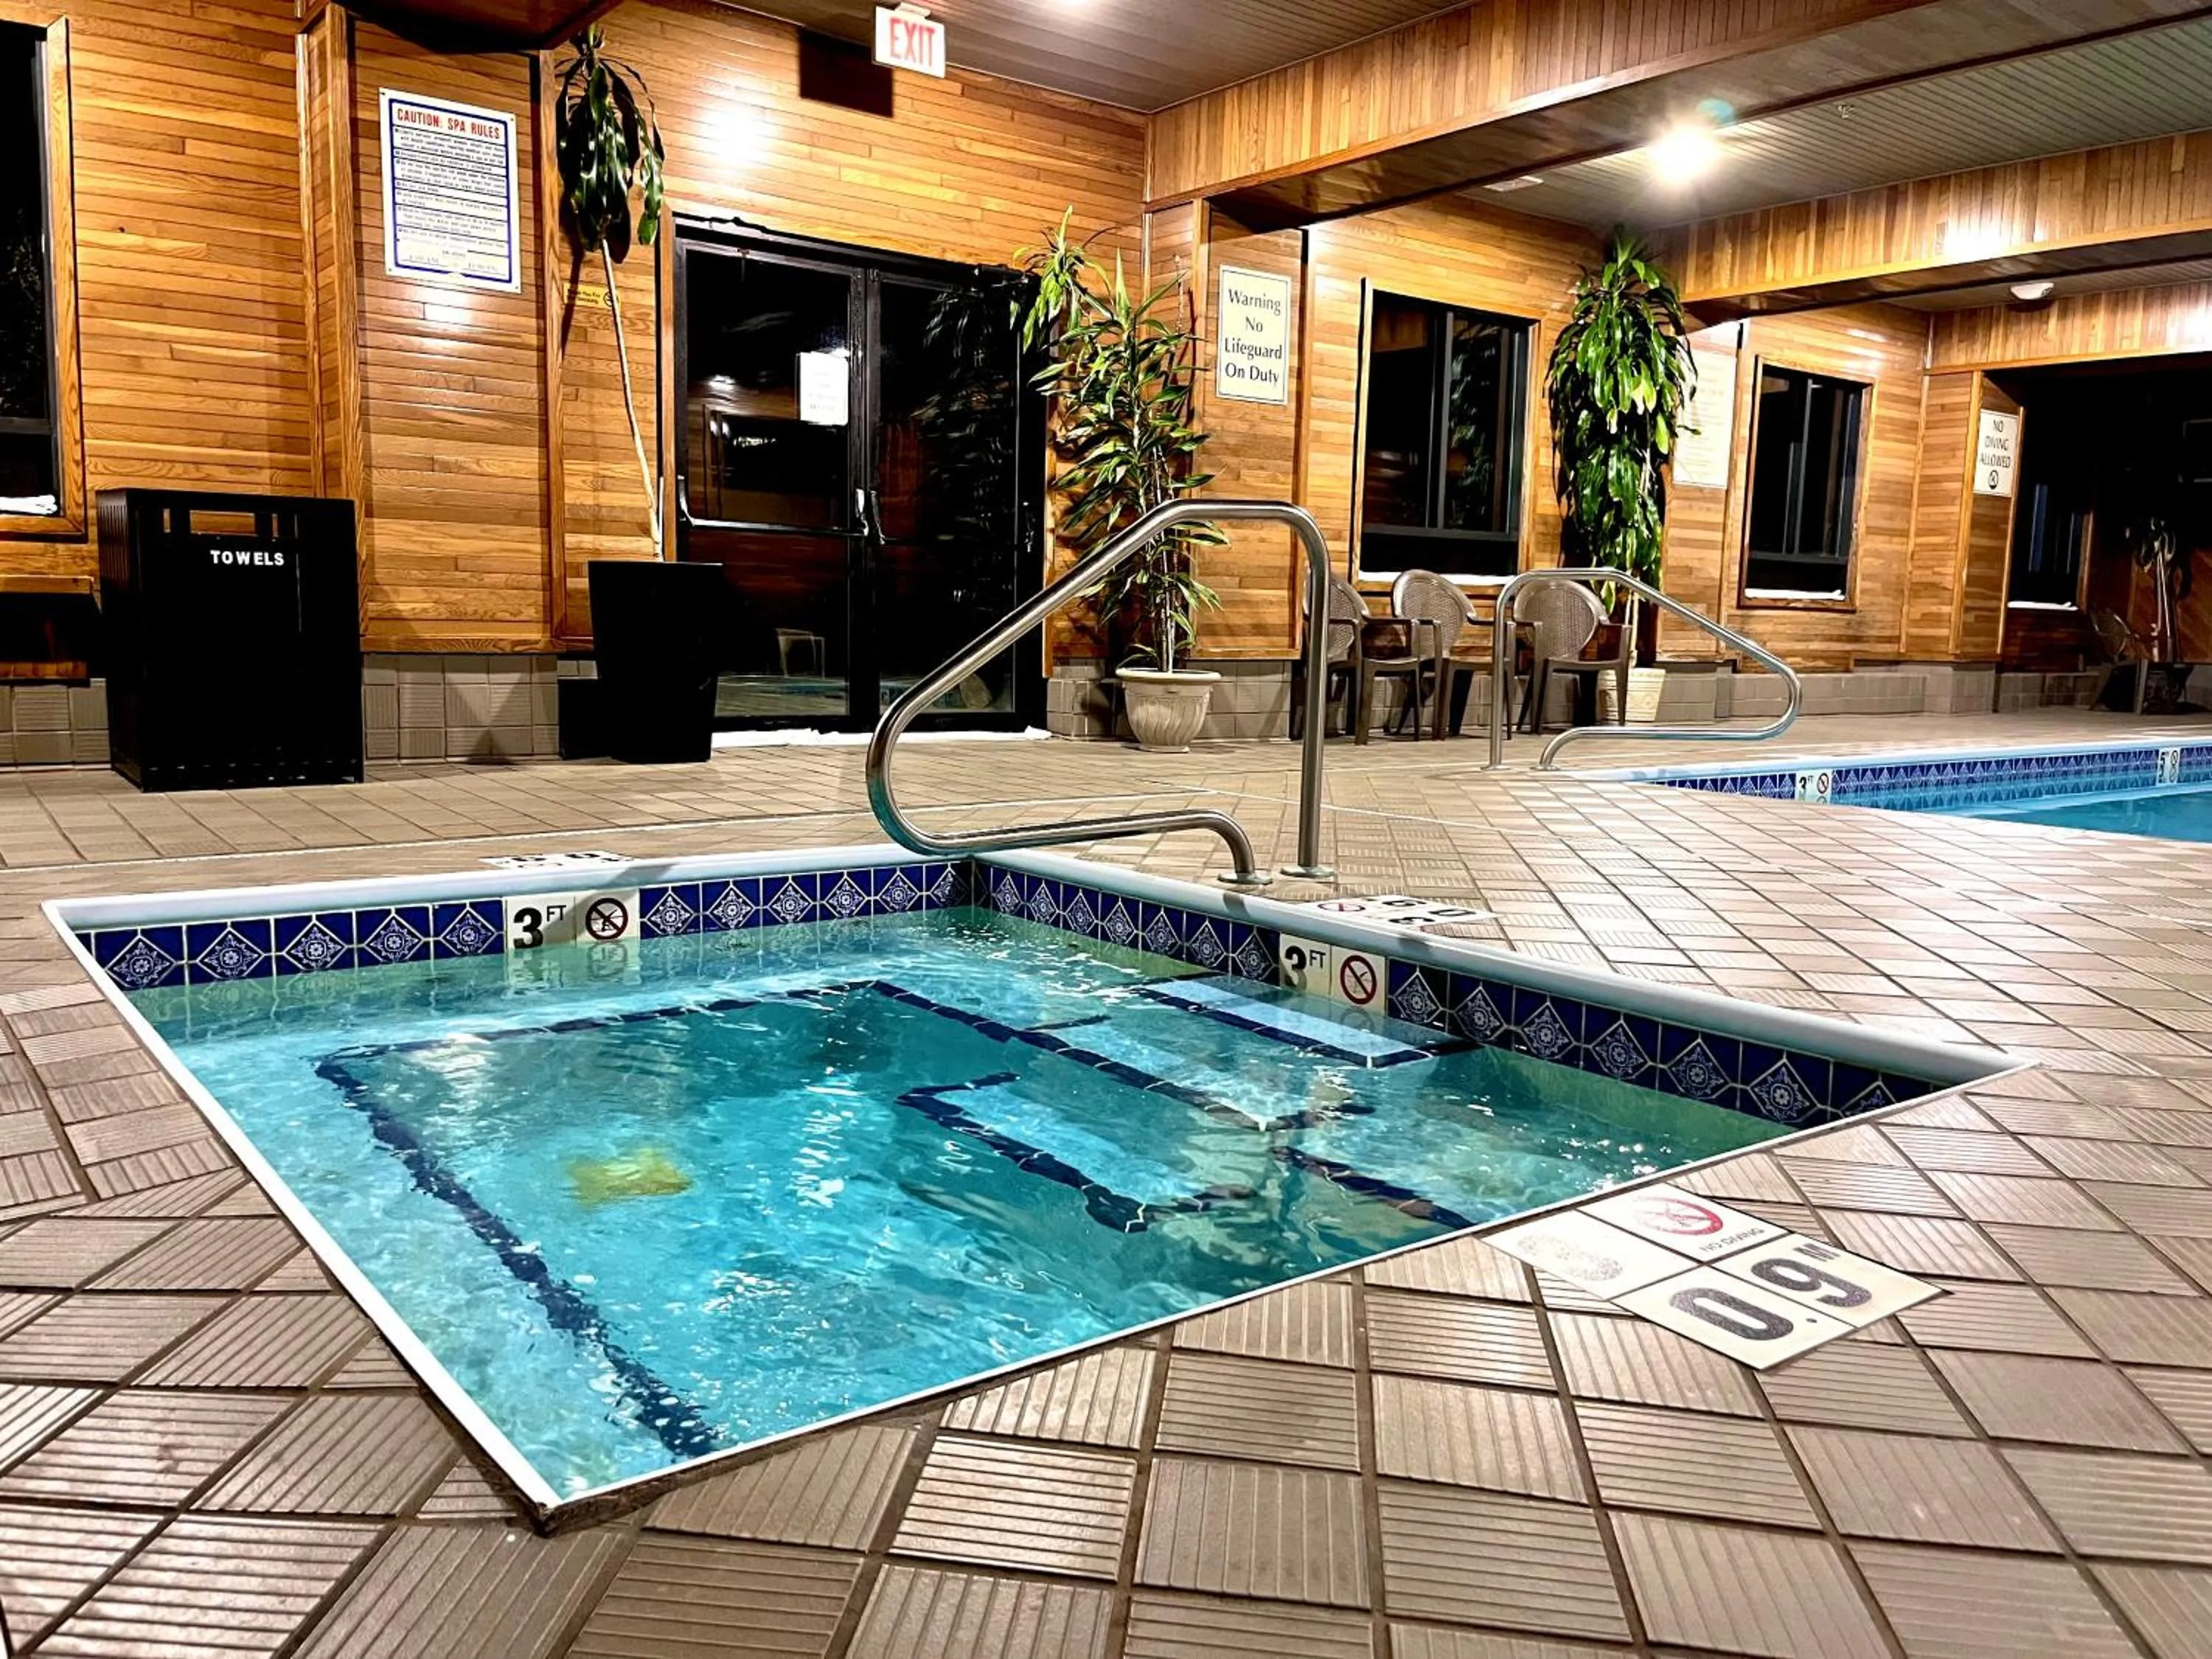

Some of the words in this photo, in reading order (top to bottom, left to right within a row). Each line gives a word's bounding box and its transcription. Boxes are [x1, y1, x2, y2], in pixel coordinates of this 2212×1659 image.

[889, 17, 936, 67] EXIT
[448, 117, 466, 132] SPA
[471, 122, 501, 139] RULES
[1228, 288, 1281, 316] Warning
[1245, 316, 1263, 332] No
[1225, 337, 1282, 360] Lifeguard
[1225, 362, 1245, 378] On
[1250, 365, 1279, 387] Duty
[1993, 419, 2004, 433] NO
[1984, 435, 2009, 451] DIVING
[1980, 452, 2011, 468] ALLOWED
[210, 549, 285, 566] TOWELS
